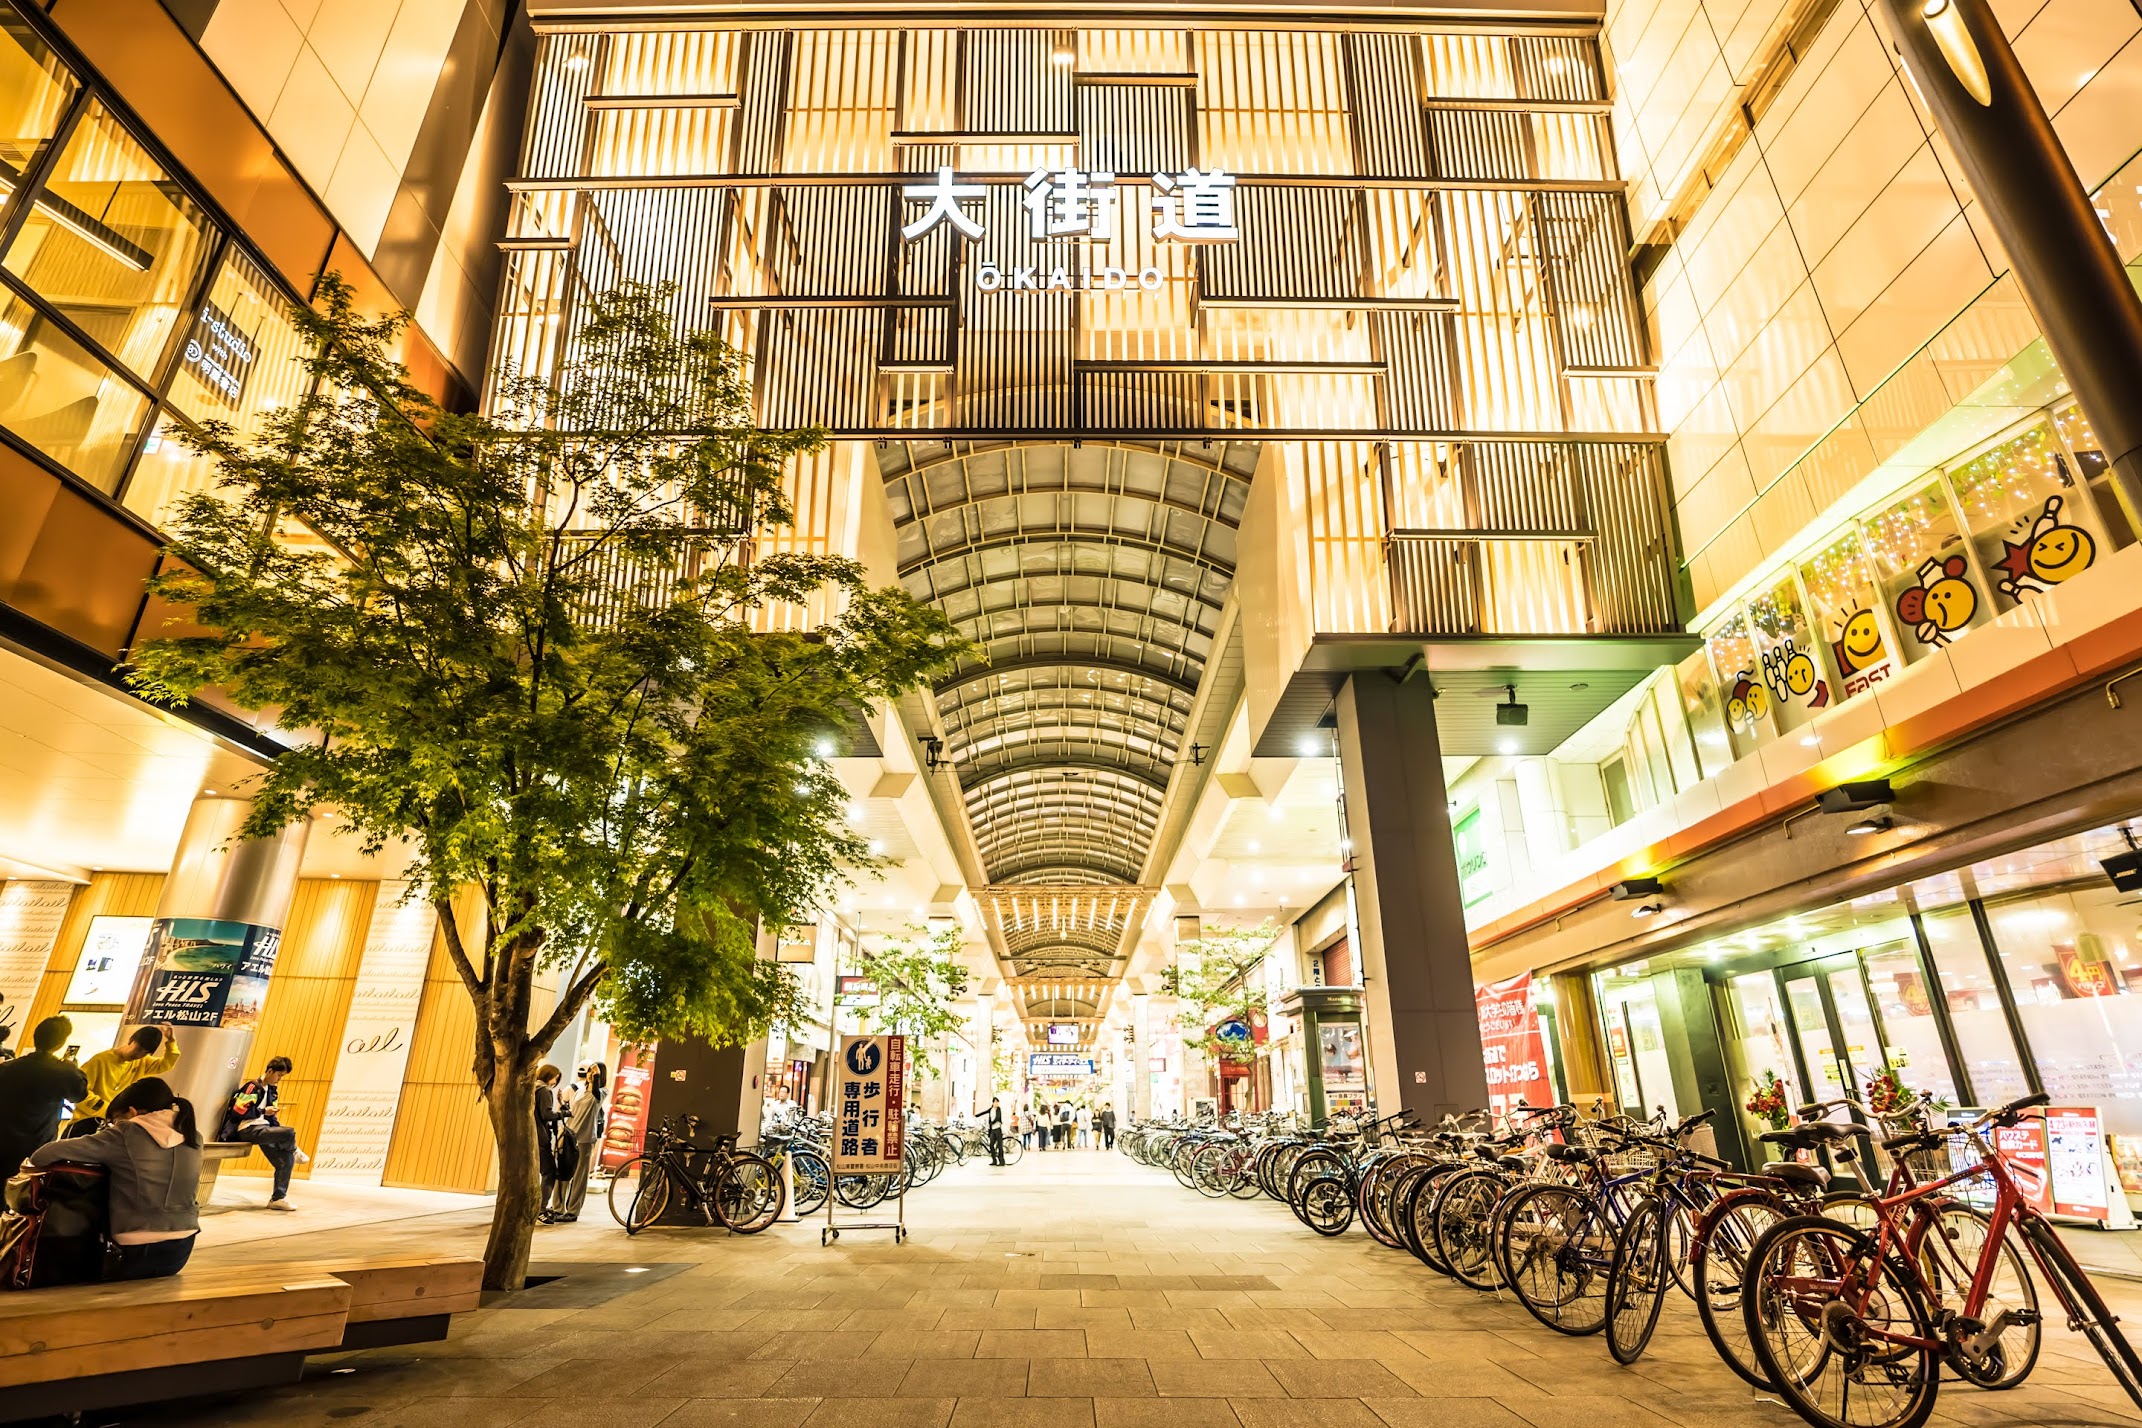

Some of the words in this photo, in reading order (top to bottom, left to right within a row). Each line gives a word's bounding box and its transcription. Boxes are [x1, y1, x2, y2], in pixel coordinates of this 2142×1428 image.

[901, 165, 1240, 245] 大街道
[212, 342, 228, 361] with
[142, 1009, 219, 1021] アエル松山2F
[841, 1082, 861, 1156] 専用道路
[861, 1082, 880, 1156] 歩行者
